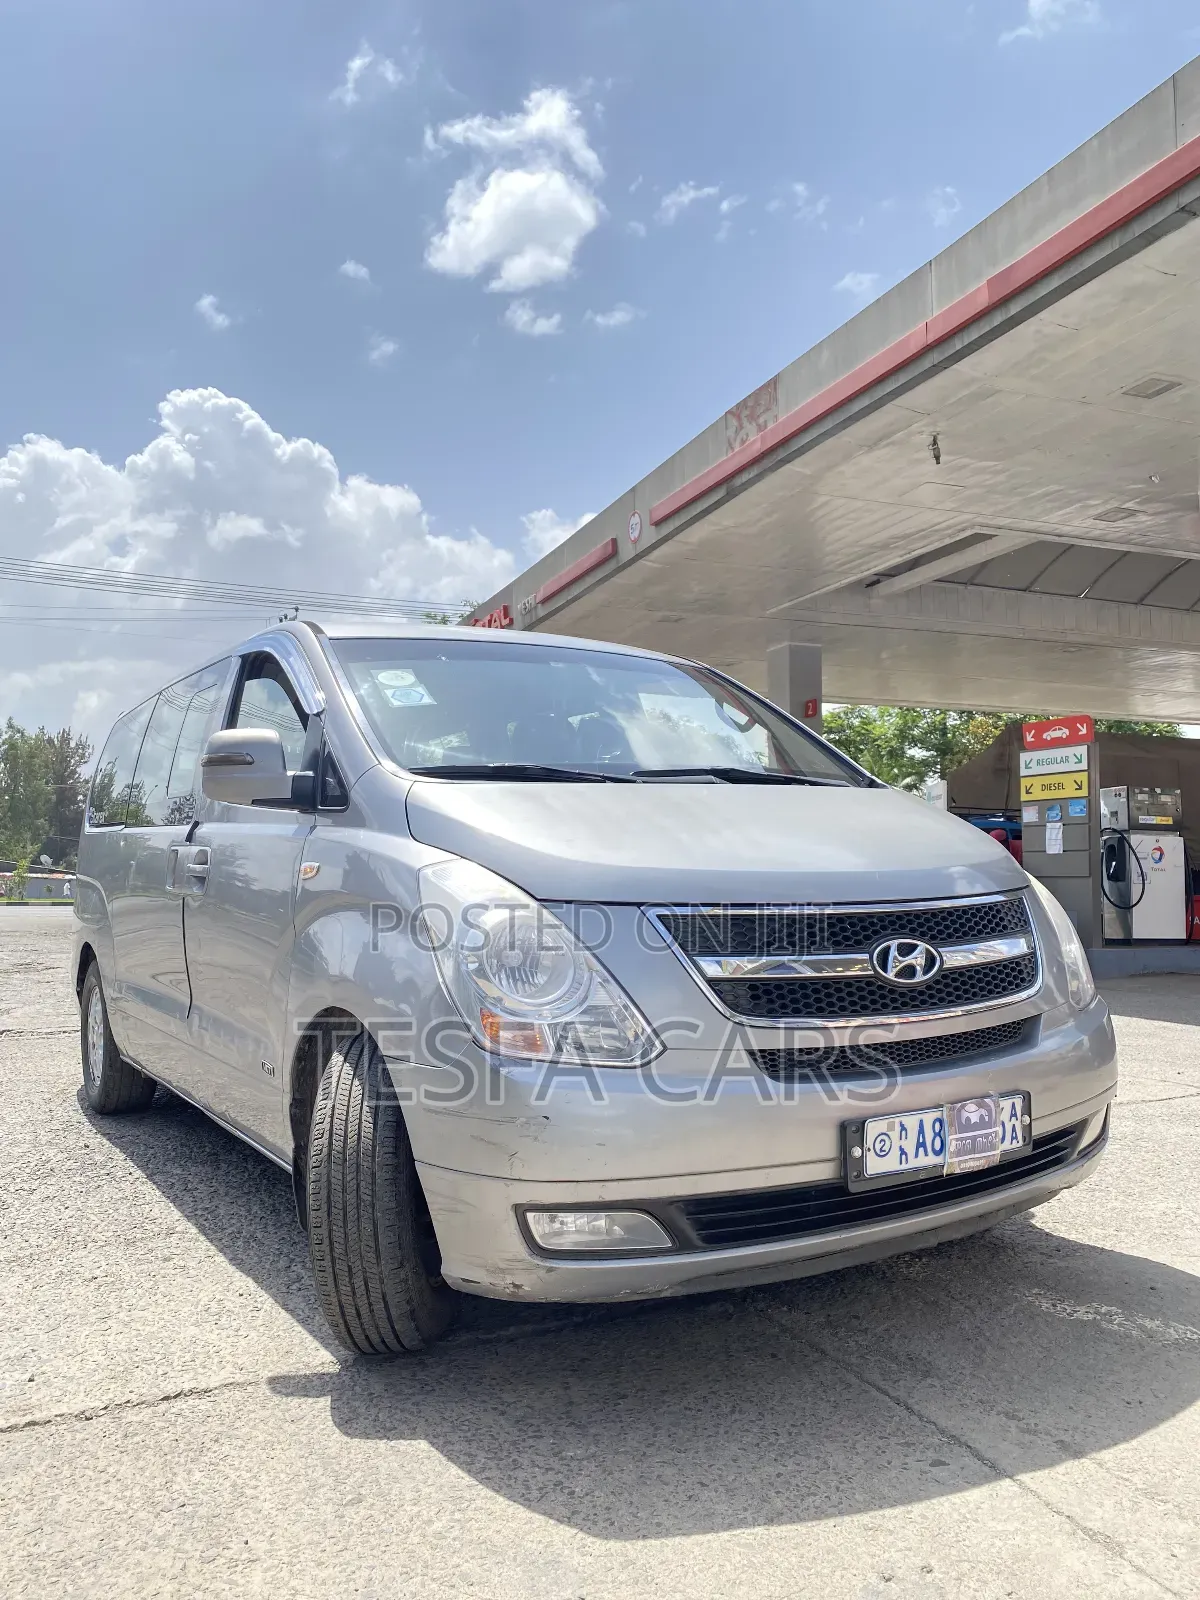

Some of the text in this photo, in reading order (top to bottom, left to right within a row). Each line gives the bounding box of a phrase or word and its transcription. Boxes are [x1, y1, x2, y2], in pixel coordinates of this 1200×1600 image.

[807, 702, 813, 715] 2
[1036, 755, 1070, 767] REGULAR
[1041, 782, 1066, 791] DIESEL
